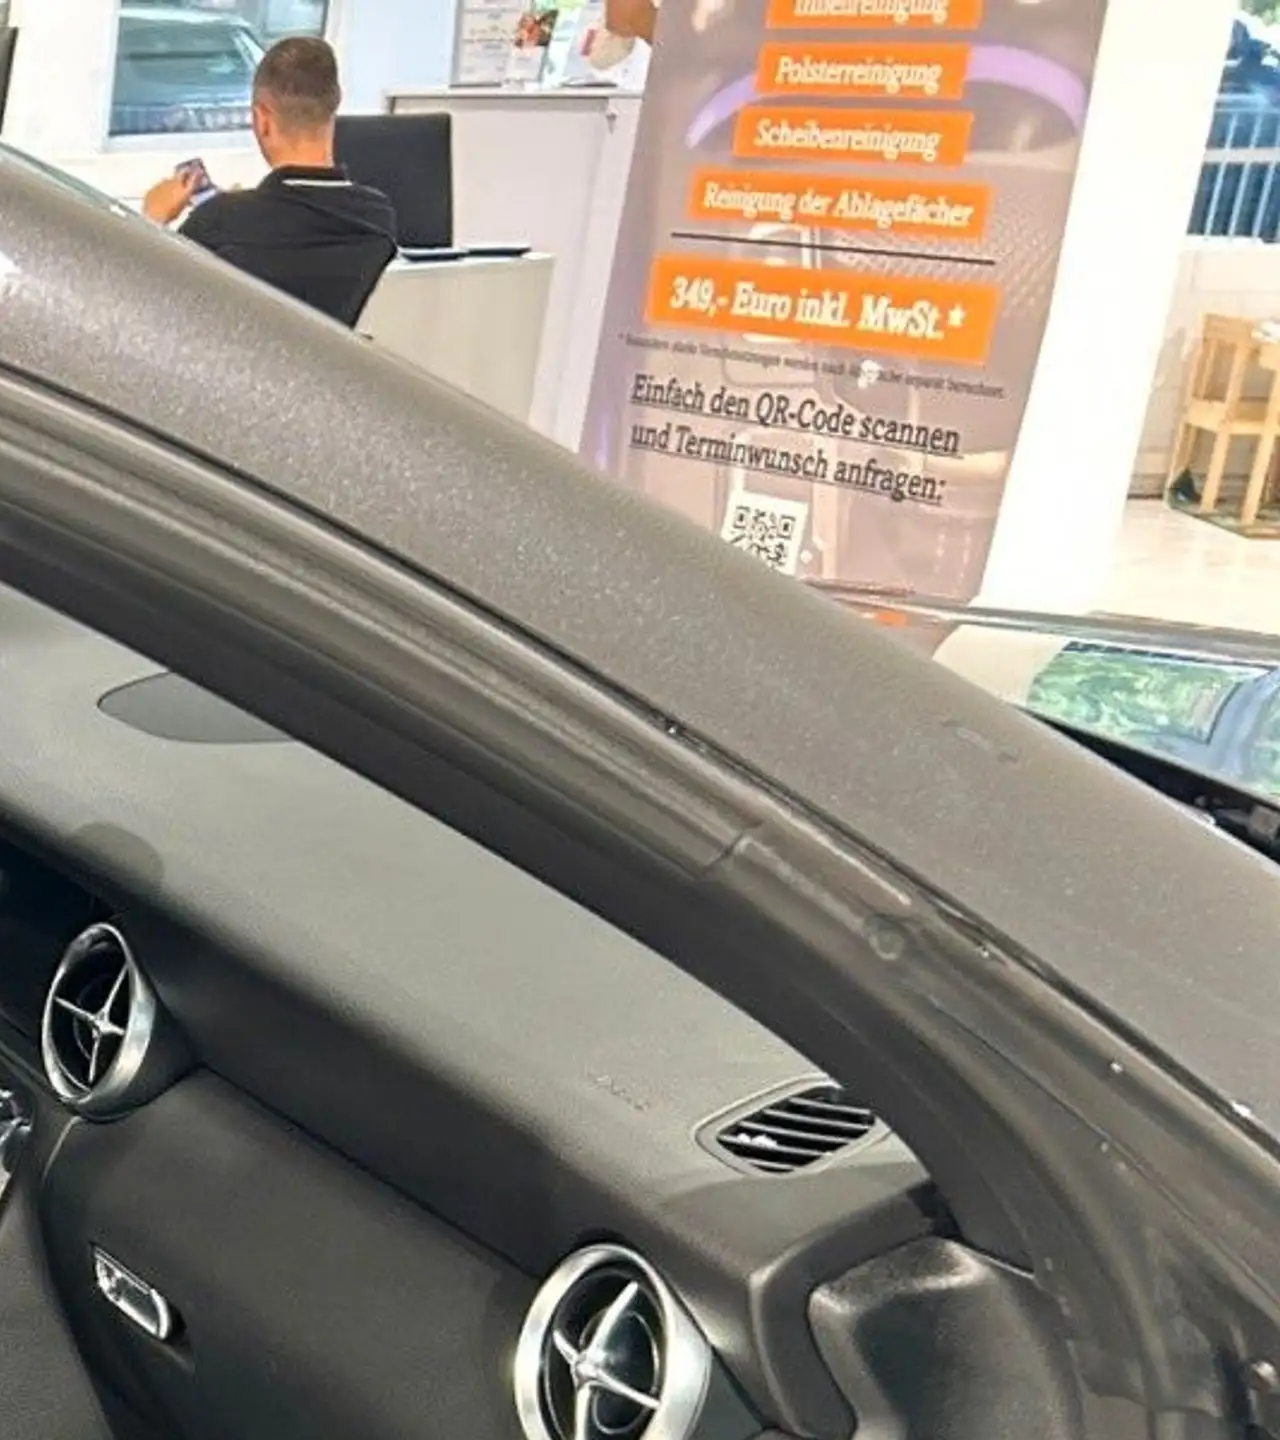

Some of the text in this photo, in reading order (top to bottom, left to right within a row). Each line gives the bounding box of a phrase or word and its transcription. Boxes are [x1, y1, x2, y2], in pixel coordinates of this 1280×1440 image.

[775, 56, 942, 94] Polsterreinigung
[754, 118, 940, 161] Scheibenreinigung
[704, 181, 974, 227] Reinigung der Ablagefächer
[731, 281, 792, 321] Euro
[795, 288, 850, 327] inkl.
[631, 373, 960, 453] Einfach den QR-Code scannen
[631, 422, 946, 503] und Terminwunsch anfragen:
